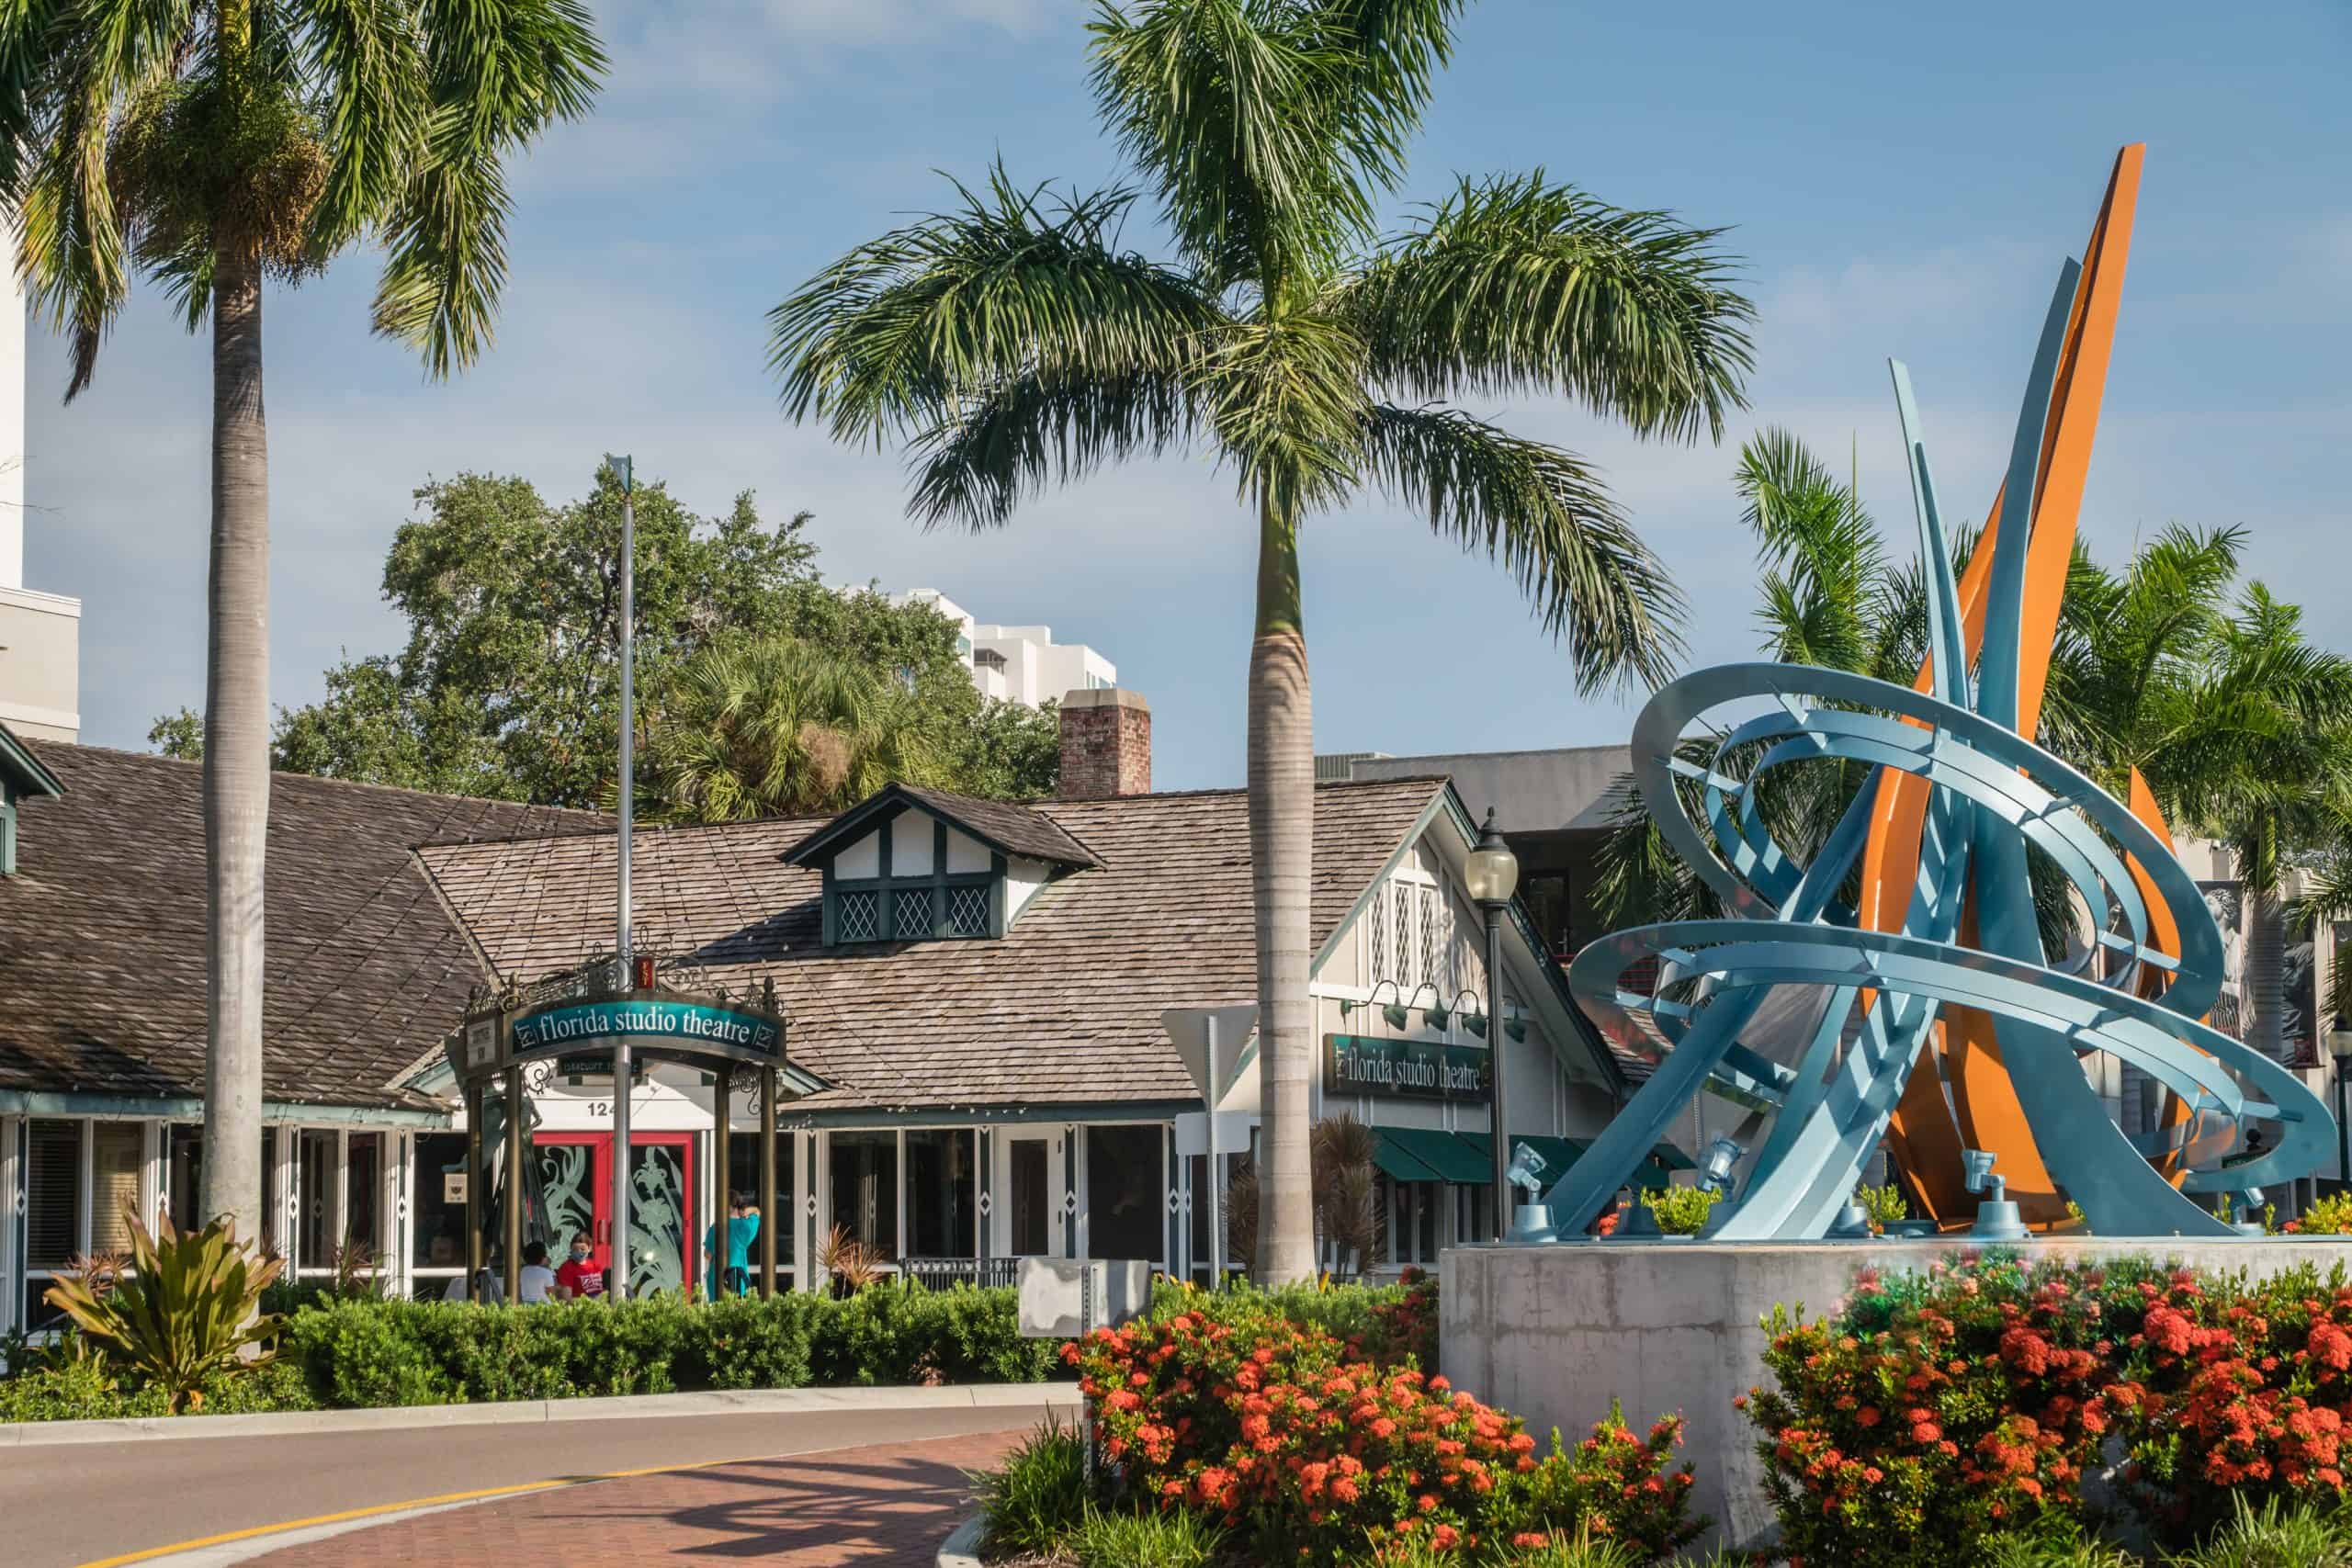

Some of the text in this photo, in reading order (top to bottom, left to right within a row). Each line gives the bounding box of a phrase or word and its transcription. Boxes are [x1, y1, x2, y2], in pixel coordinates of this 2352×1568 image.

[539, 1009, 611, 1042] florida
[615, 1006, 677, 1032] studio
[683, 1009, 751, 1043] theatre
[1348, 1046, 1393, 1084] florida
[1396, 1052, 1435, 1088] studio
[1439, 1055, 1480, 1091] theatre
